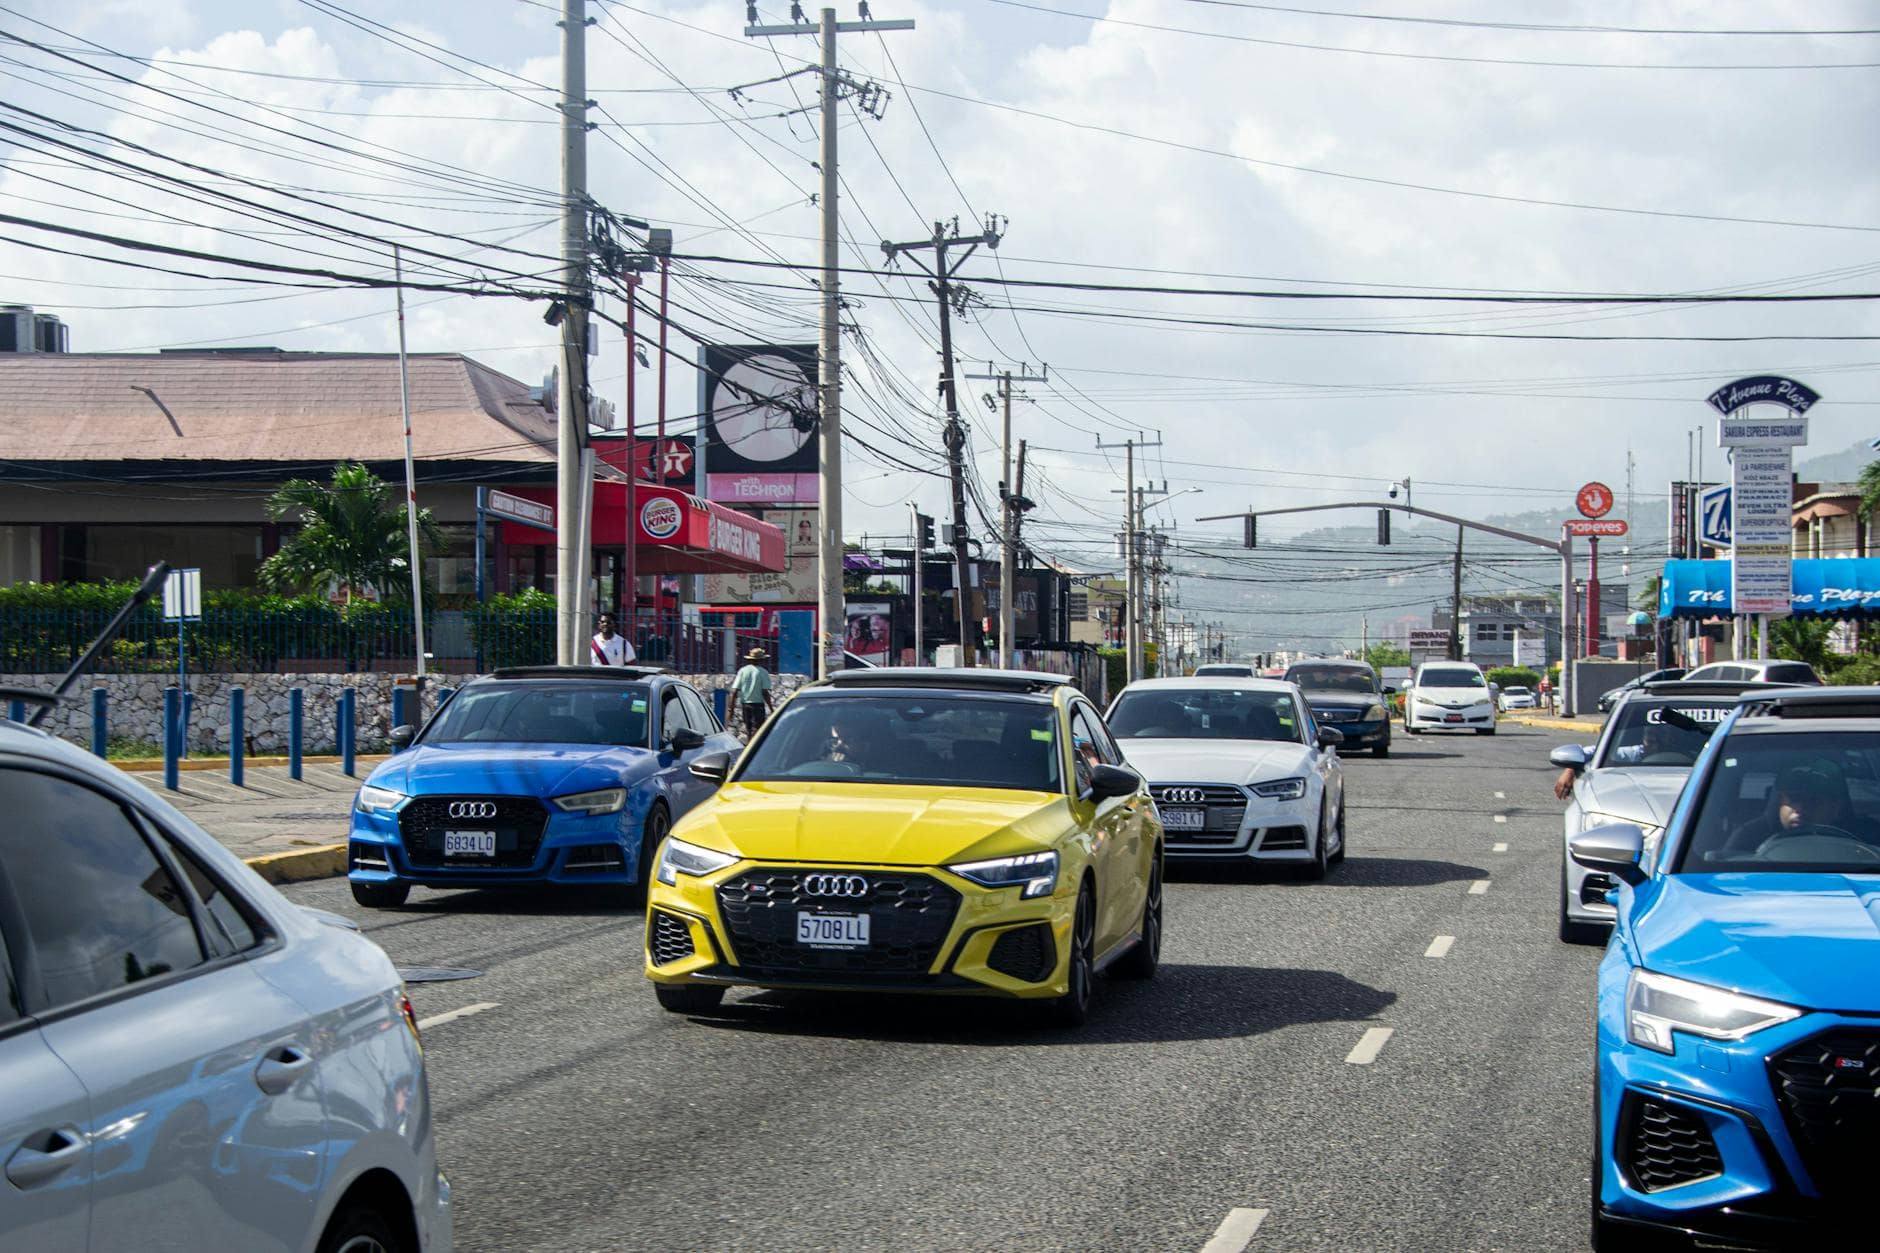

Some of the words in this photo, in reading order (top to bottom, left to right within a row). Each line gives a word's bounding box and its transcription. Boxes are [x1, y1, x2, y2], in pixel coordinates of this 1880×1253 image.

[1728, 384, 1772, 408] Avenue
[1775, 379, 1809, 409] Plaza
[1724, 425, 1745, 438] SAKURA
[1746, 425, 1769, 438] EXPRESS
[1770, 425, 1804, 437] RESTAURANT
[733, 482, 795, 498] TECHRON
[646, 506, 675, 519] BURGER
[647, 514, 676, 528] KING
[716, 518, 743, 556] BURGER
[743, 528, 761, 562] KING
[1410, 631, 1449, 639] BRYANS
